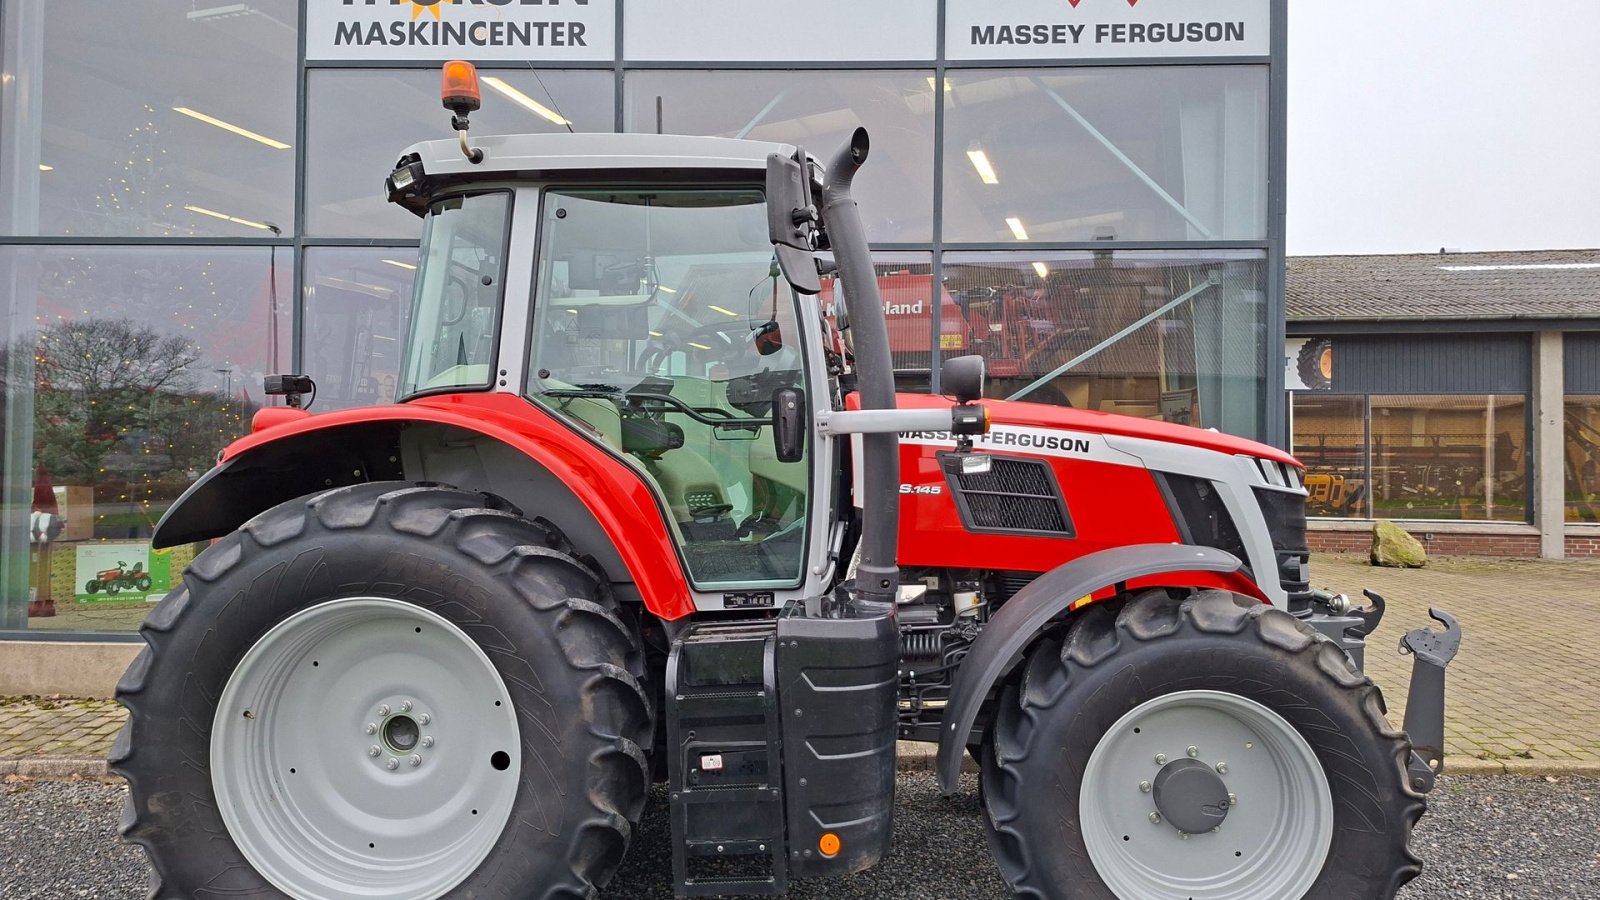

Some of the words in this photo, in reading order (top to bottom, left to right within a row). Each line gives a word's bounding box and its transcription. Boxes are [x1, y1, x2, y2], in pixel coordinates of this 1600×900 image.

[334, 21, 587, 46] MASKINCENTER
[970, 24, 1085, 45] MASSEY
[1095, 21, 1245, 43] FERGUSON
[980, 430, 1090, 453] FERGUSON
